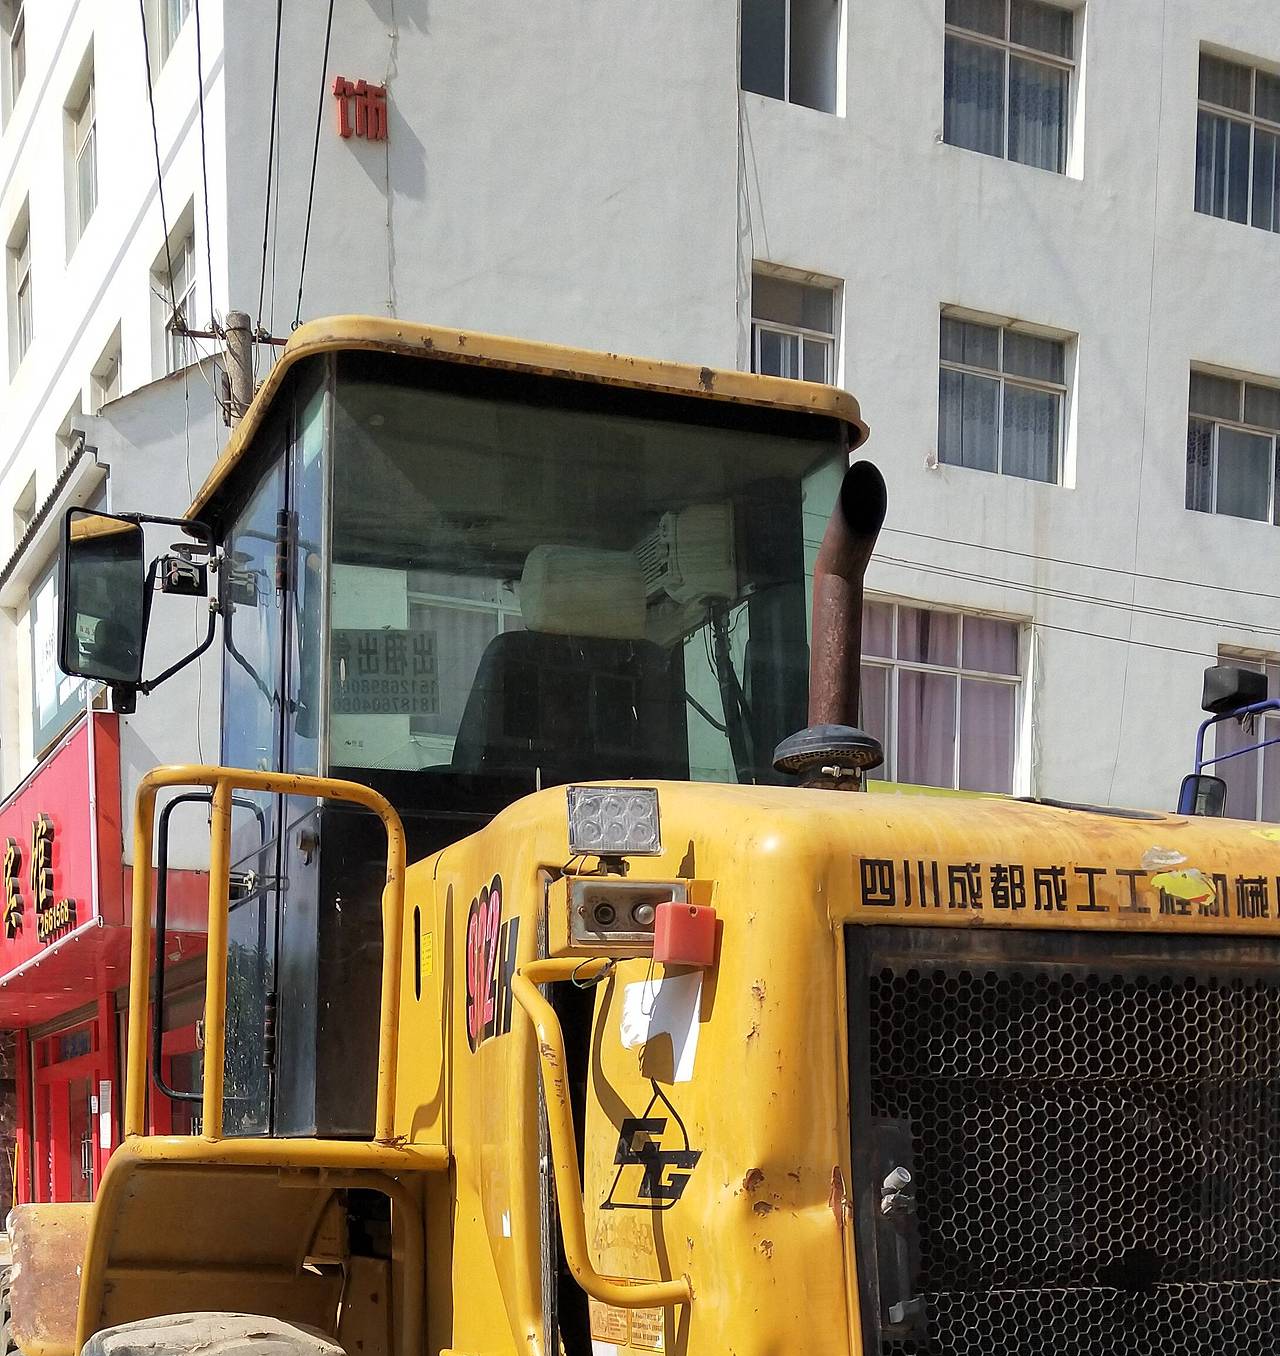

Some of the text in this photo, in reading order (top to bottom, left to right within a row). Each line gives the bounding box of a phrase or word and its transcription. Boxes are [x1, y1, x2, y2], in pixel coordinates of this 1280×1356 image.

[333, 76, 388, 141] 饰
[859, 857, 1280, 919] 四川成都成工工机械
